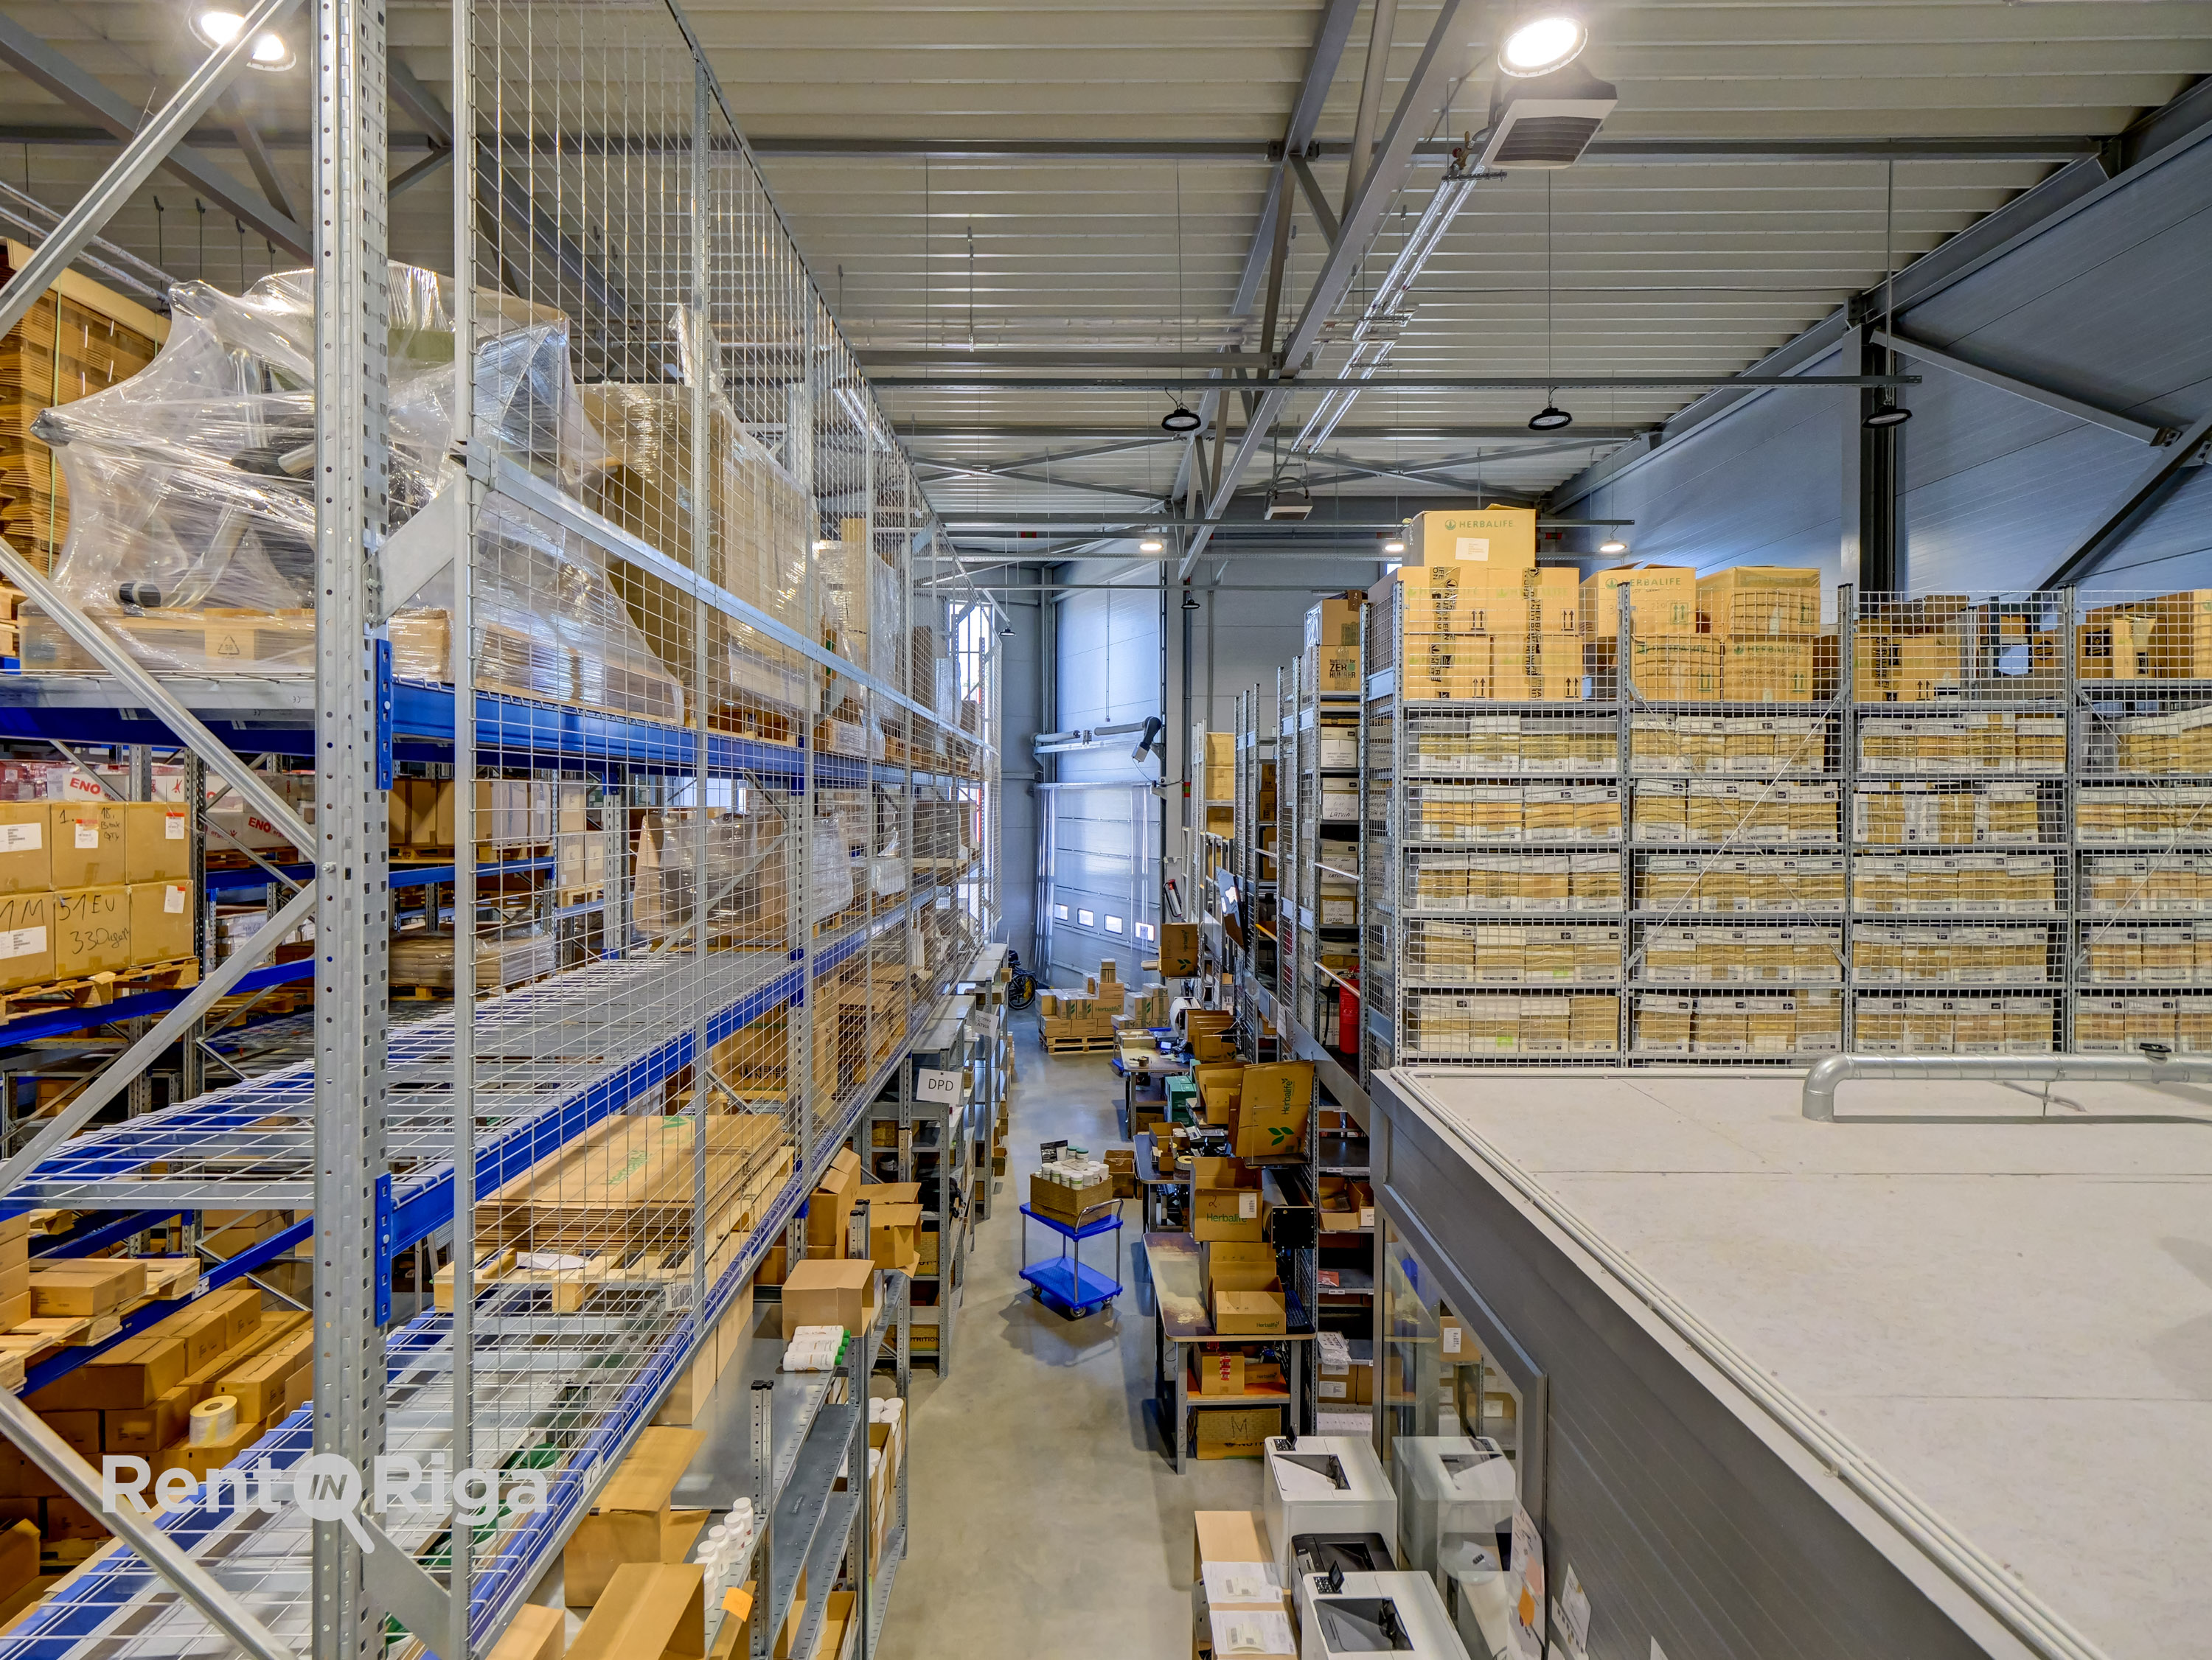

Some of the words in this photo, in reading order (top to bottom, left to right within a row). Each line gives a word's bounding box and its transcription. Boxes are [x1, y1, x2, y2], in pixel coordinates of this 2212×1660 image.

[1459, 520, 1514, 529] HERBALIFE
[1747, 645, 1801, 654] HERBALIFE
[69, 778, 102, 795] ENO
[248, 816, 271, 833] ENO
[928, 1078, 953, 1091] DPD
[1281, 1080, 1293, 1115] Herbalife
[1206, 1213, 1248, 1222] Herbalife
[1231, 1416, 1249, 1440] M
